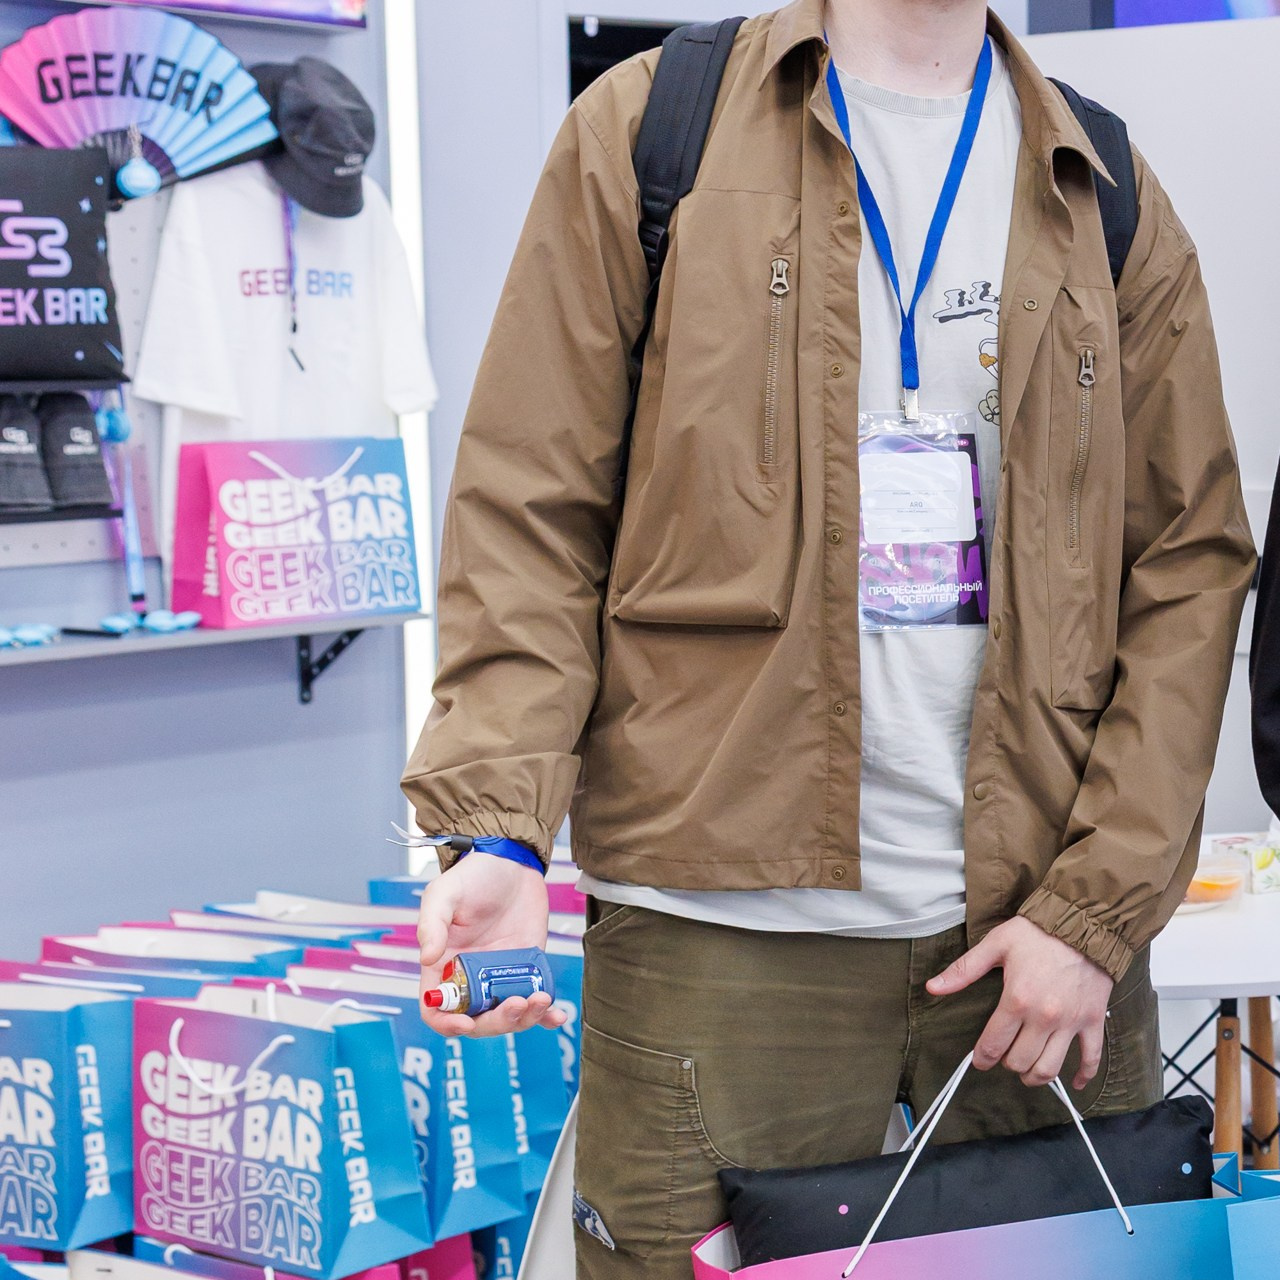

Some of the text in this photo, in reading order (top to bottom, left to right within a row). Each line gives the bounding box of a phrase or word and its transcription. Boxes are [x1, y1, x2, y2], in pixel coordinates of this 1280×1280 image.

[43, 287, 109, 325] BAR
[240, 268, 353, 297] GEE BAR
[218, 472, 403, 525] GEEK BAR
[223, 495, 409, 550] GEEK BAR
[225, 544, 330, 596] GEEK
[330, 538, 413, 572] BAR
[230, 563, 418, 621] GEEK BAR
[868, 580, 982, 596] ПРОФЕССИОНАЛЬНЫЙ
[894, 593, 959, 605] ПОСЕТИТЕЛЬ
[140, 1050, 324, 1124] GEEK BAR
[84, 1132, 111, 1200] BAR
[141, 1103, 322, 1174] GEEK BAR
[333, 1067, 377, 1227] GEEK BAR
[450, 1123, 477, 1192] BAR
[140, 1140, 322, 1223] GEEK BAR
[140, 1191, 323, 1271] GEEK BAR
